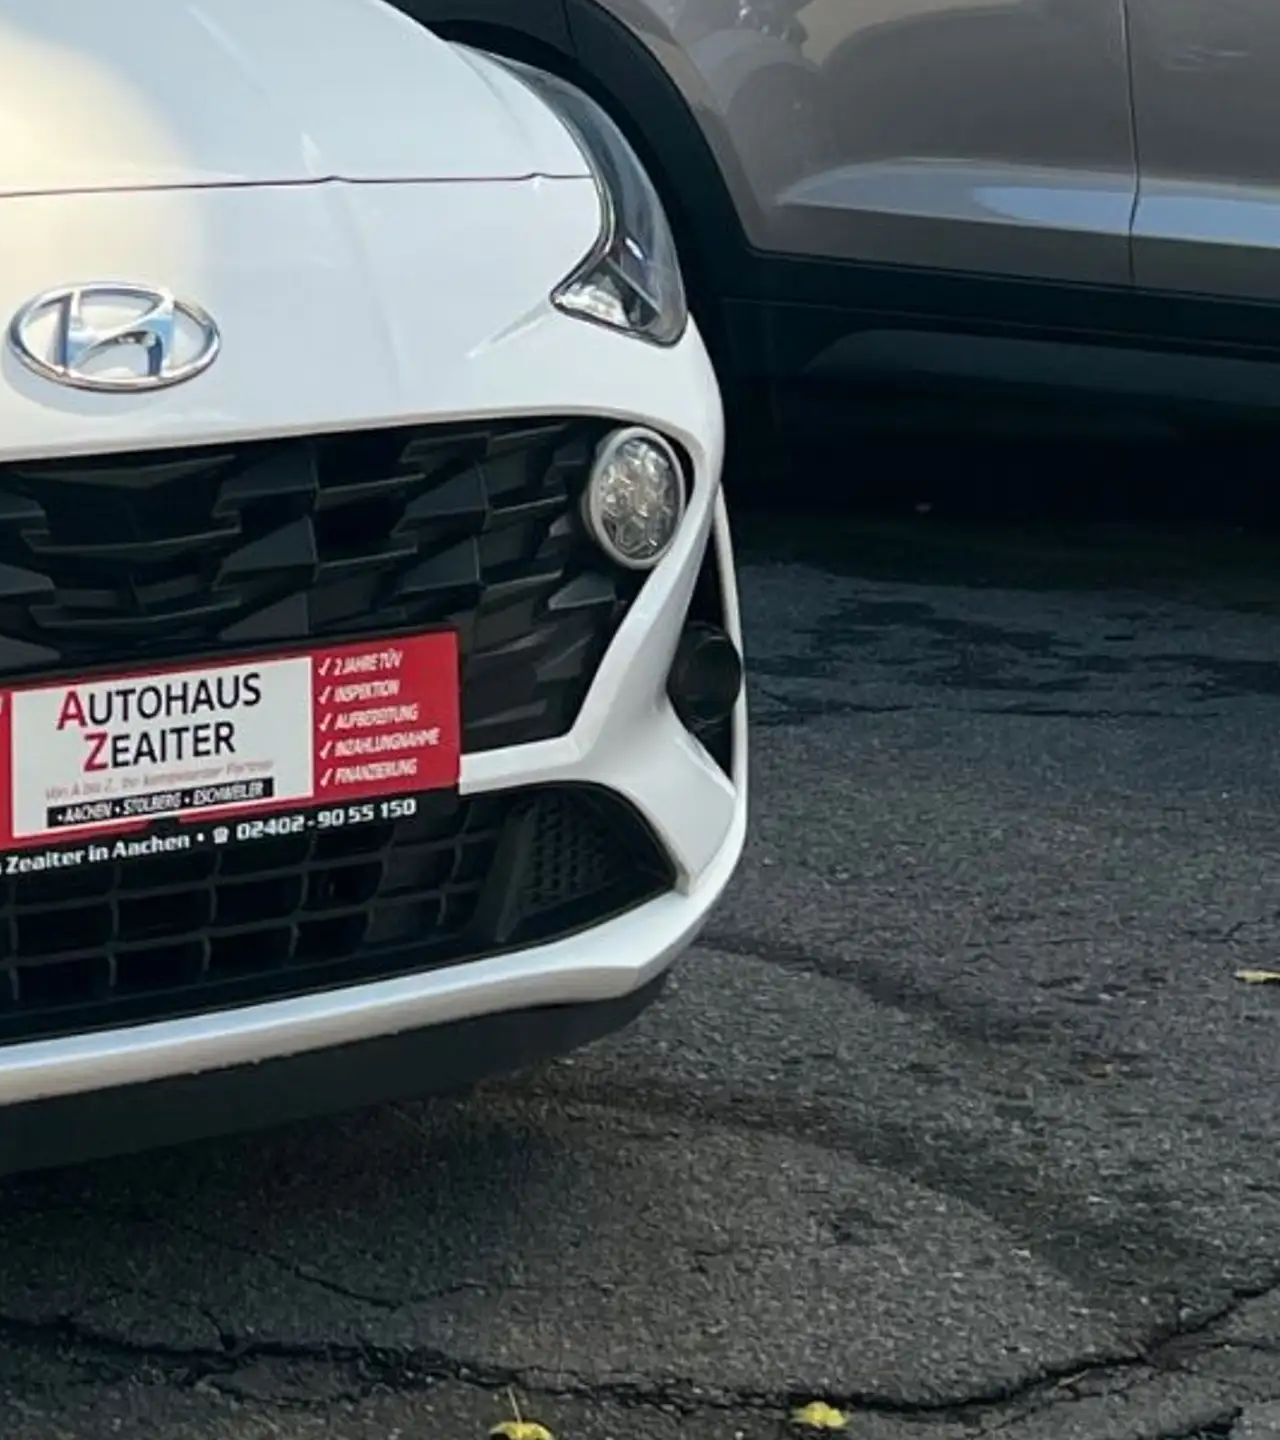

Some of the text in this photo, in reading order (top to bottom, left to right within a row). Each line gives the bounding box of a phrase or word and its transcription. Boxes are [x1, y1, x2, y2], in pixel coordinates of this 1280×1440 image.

[56, 672, 261, 730] AUTOHAUS
[84, 721, 236, 773] ZEAITER
[64, 781, 265, 823] AACHEN STOLBERG ESCHWEILER
[5, 847, 84, 875] Zeaiter
[88, 842, 108, 862] in
[111, 832, 190, 860] Aachen
[236, 815, 306, 841] 02402
[380, 798, 417, 820] 150
